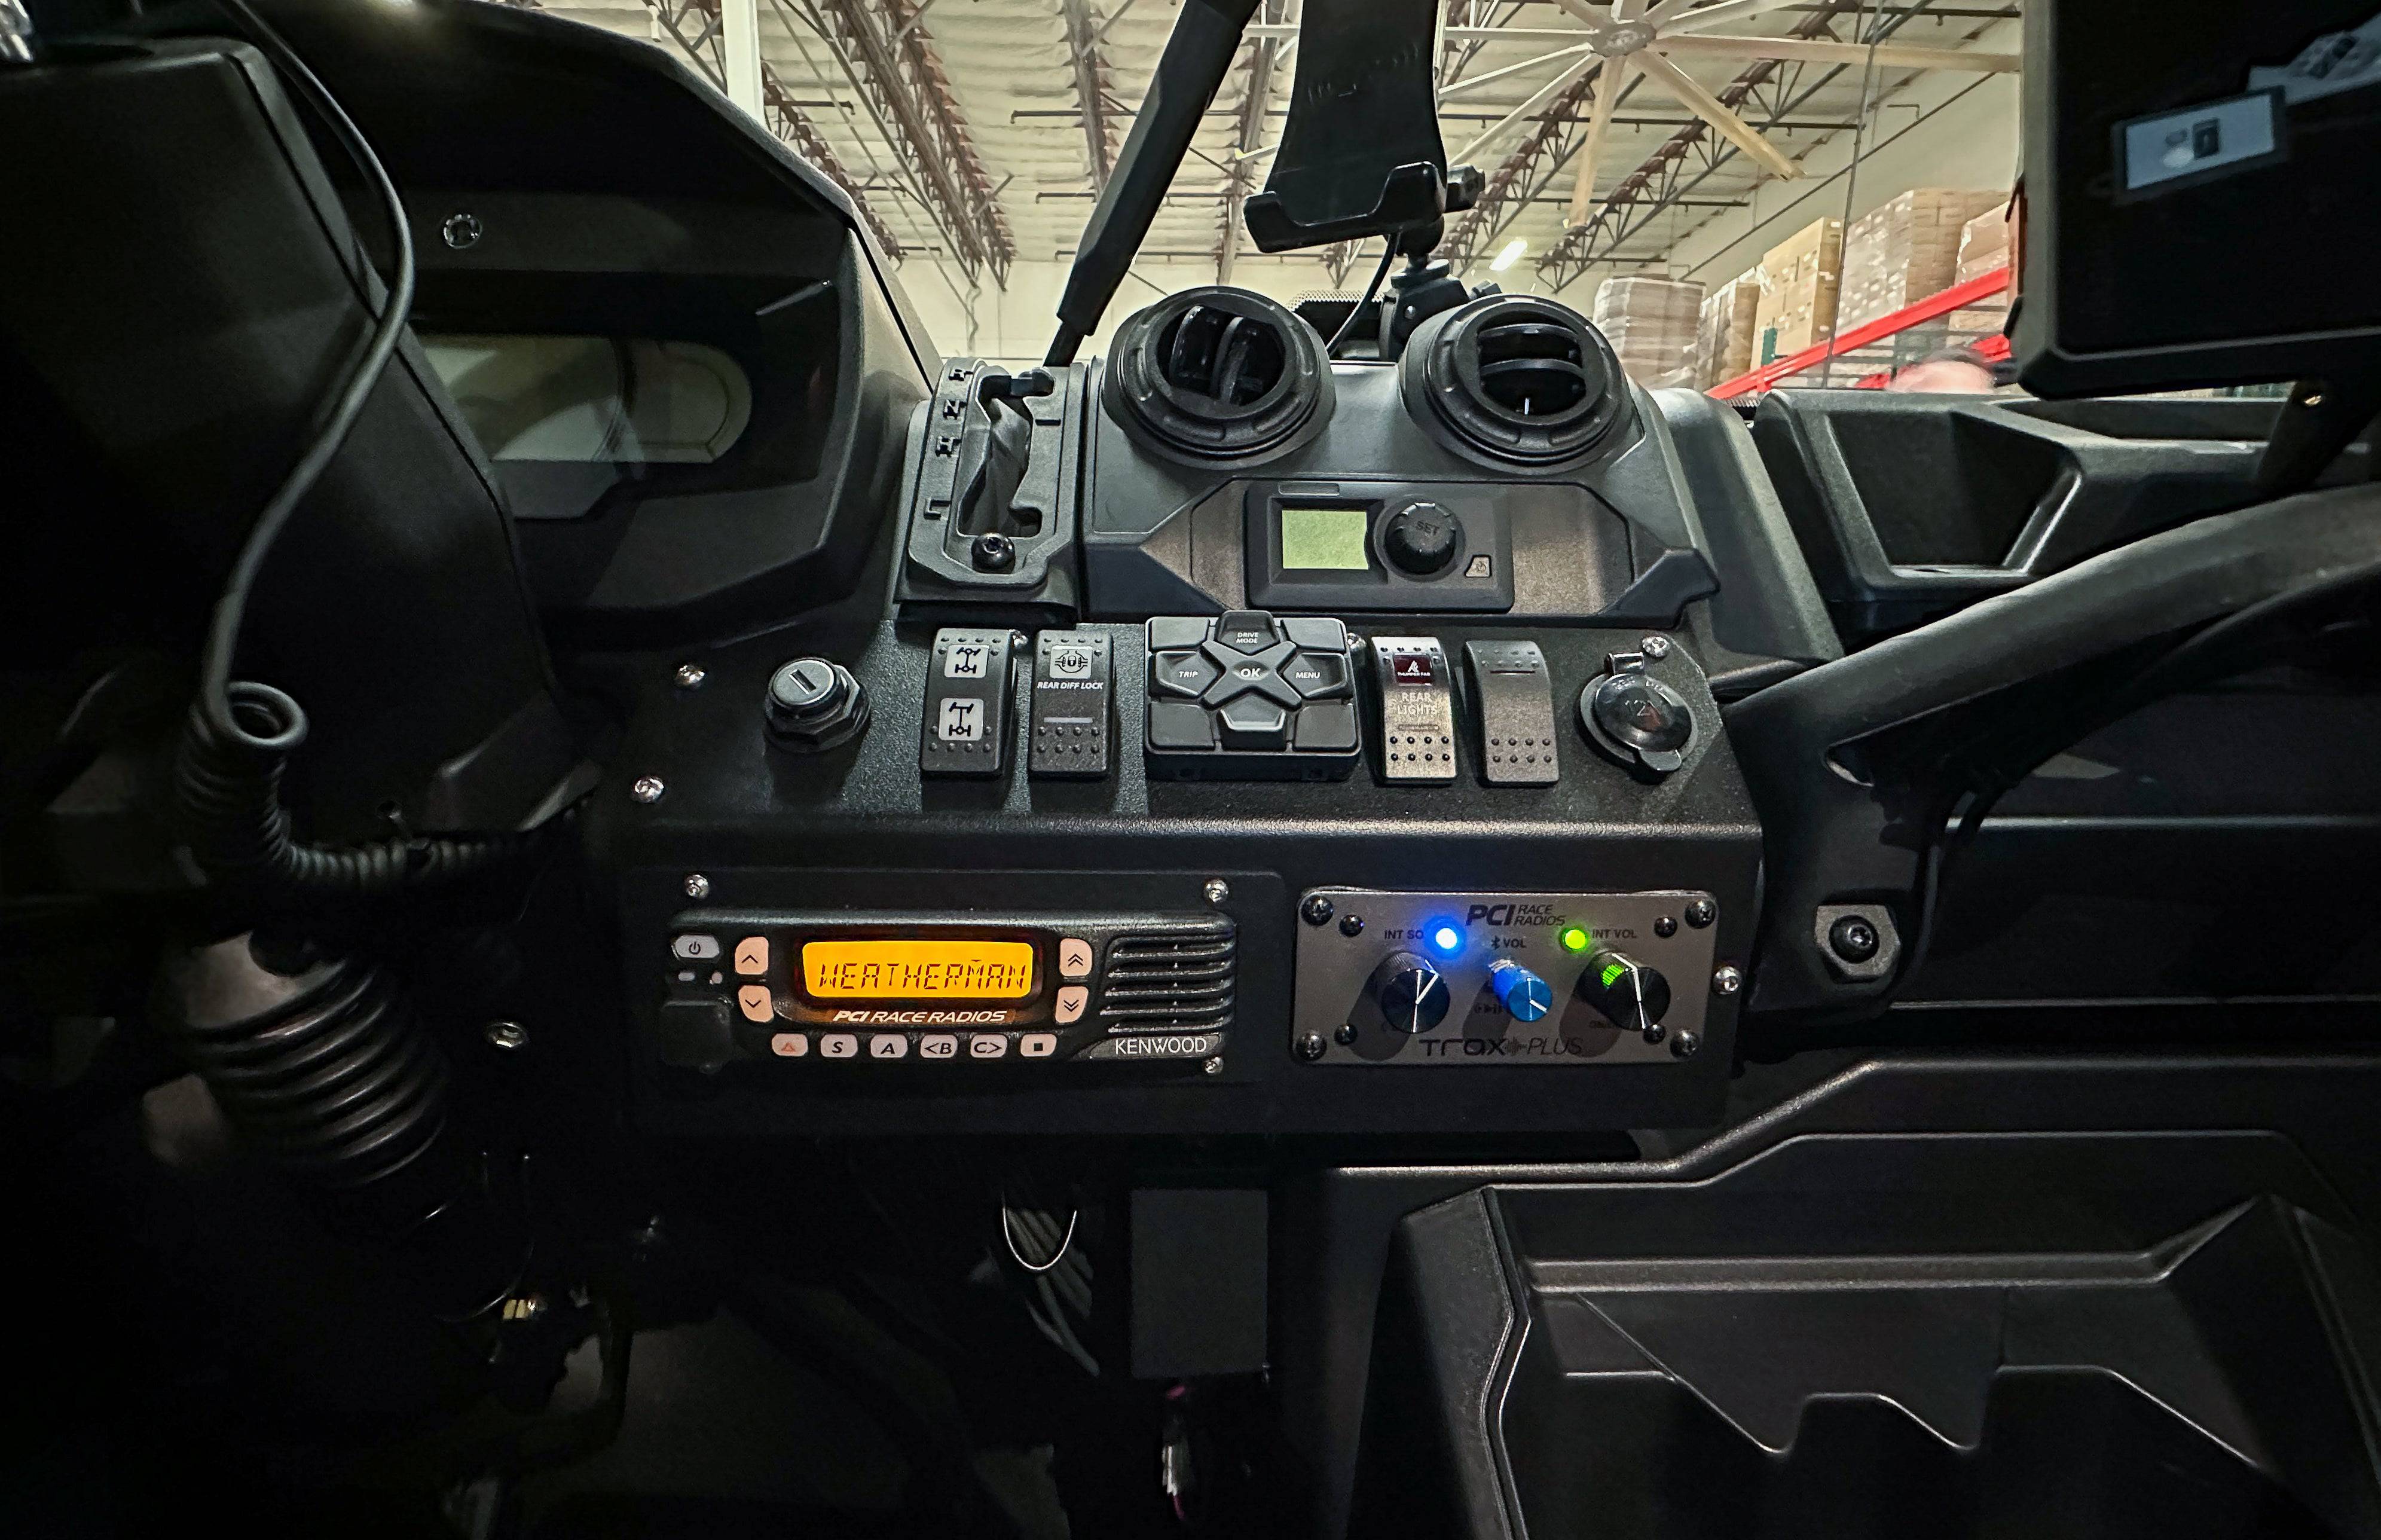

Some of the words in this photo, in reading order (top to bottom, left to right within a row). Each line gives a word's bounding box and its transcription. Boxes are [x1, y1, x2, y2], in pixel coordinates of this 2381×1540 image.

[1416, 521, 1439, 535] SET
[1240, 668, 1261, 678] OK
[1401, 692, 1432, 702] REAR
[1398, 704, 1438, 716] LIGHTS
[1465, 905, 1515, 926] PCI
[1514, 915, 1566, 926] RADIOS
[1384, 930, 1402, 939] INT
[1593, 929, 1609, 937] INT
[1615, 929, 1637, 937] VOL
[1503, 938, 1527, 948] VOL
[819, 960, 1026, 989] WEATHERMAN
[833, 1010, 870, 1021] PCI
[870, 1011, 927, 1022] RACE
[927, 1010, 1007, 1022] RADIOS
[832, 1041, 843, 1053] S
[880, 1043, 895, 1054] A
[1115, 1037, 1207, 1055] KENWOOD
[1527, 1037, 1584, 1055] PLUS
